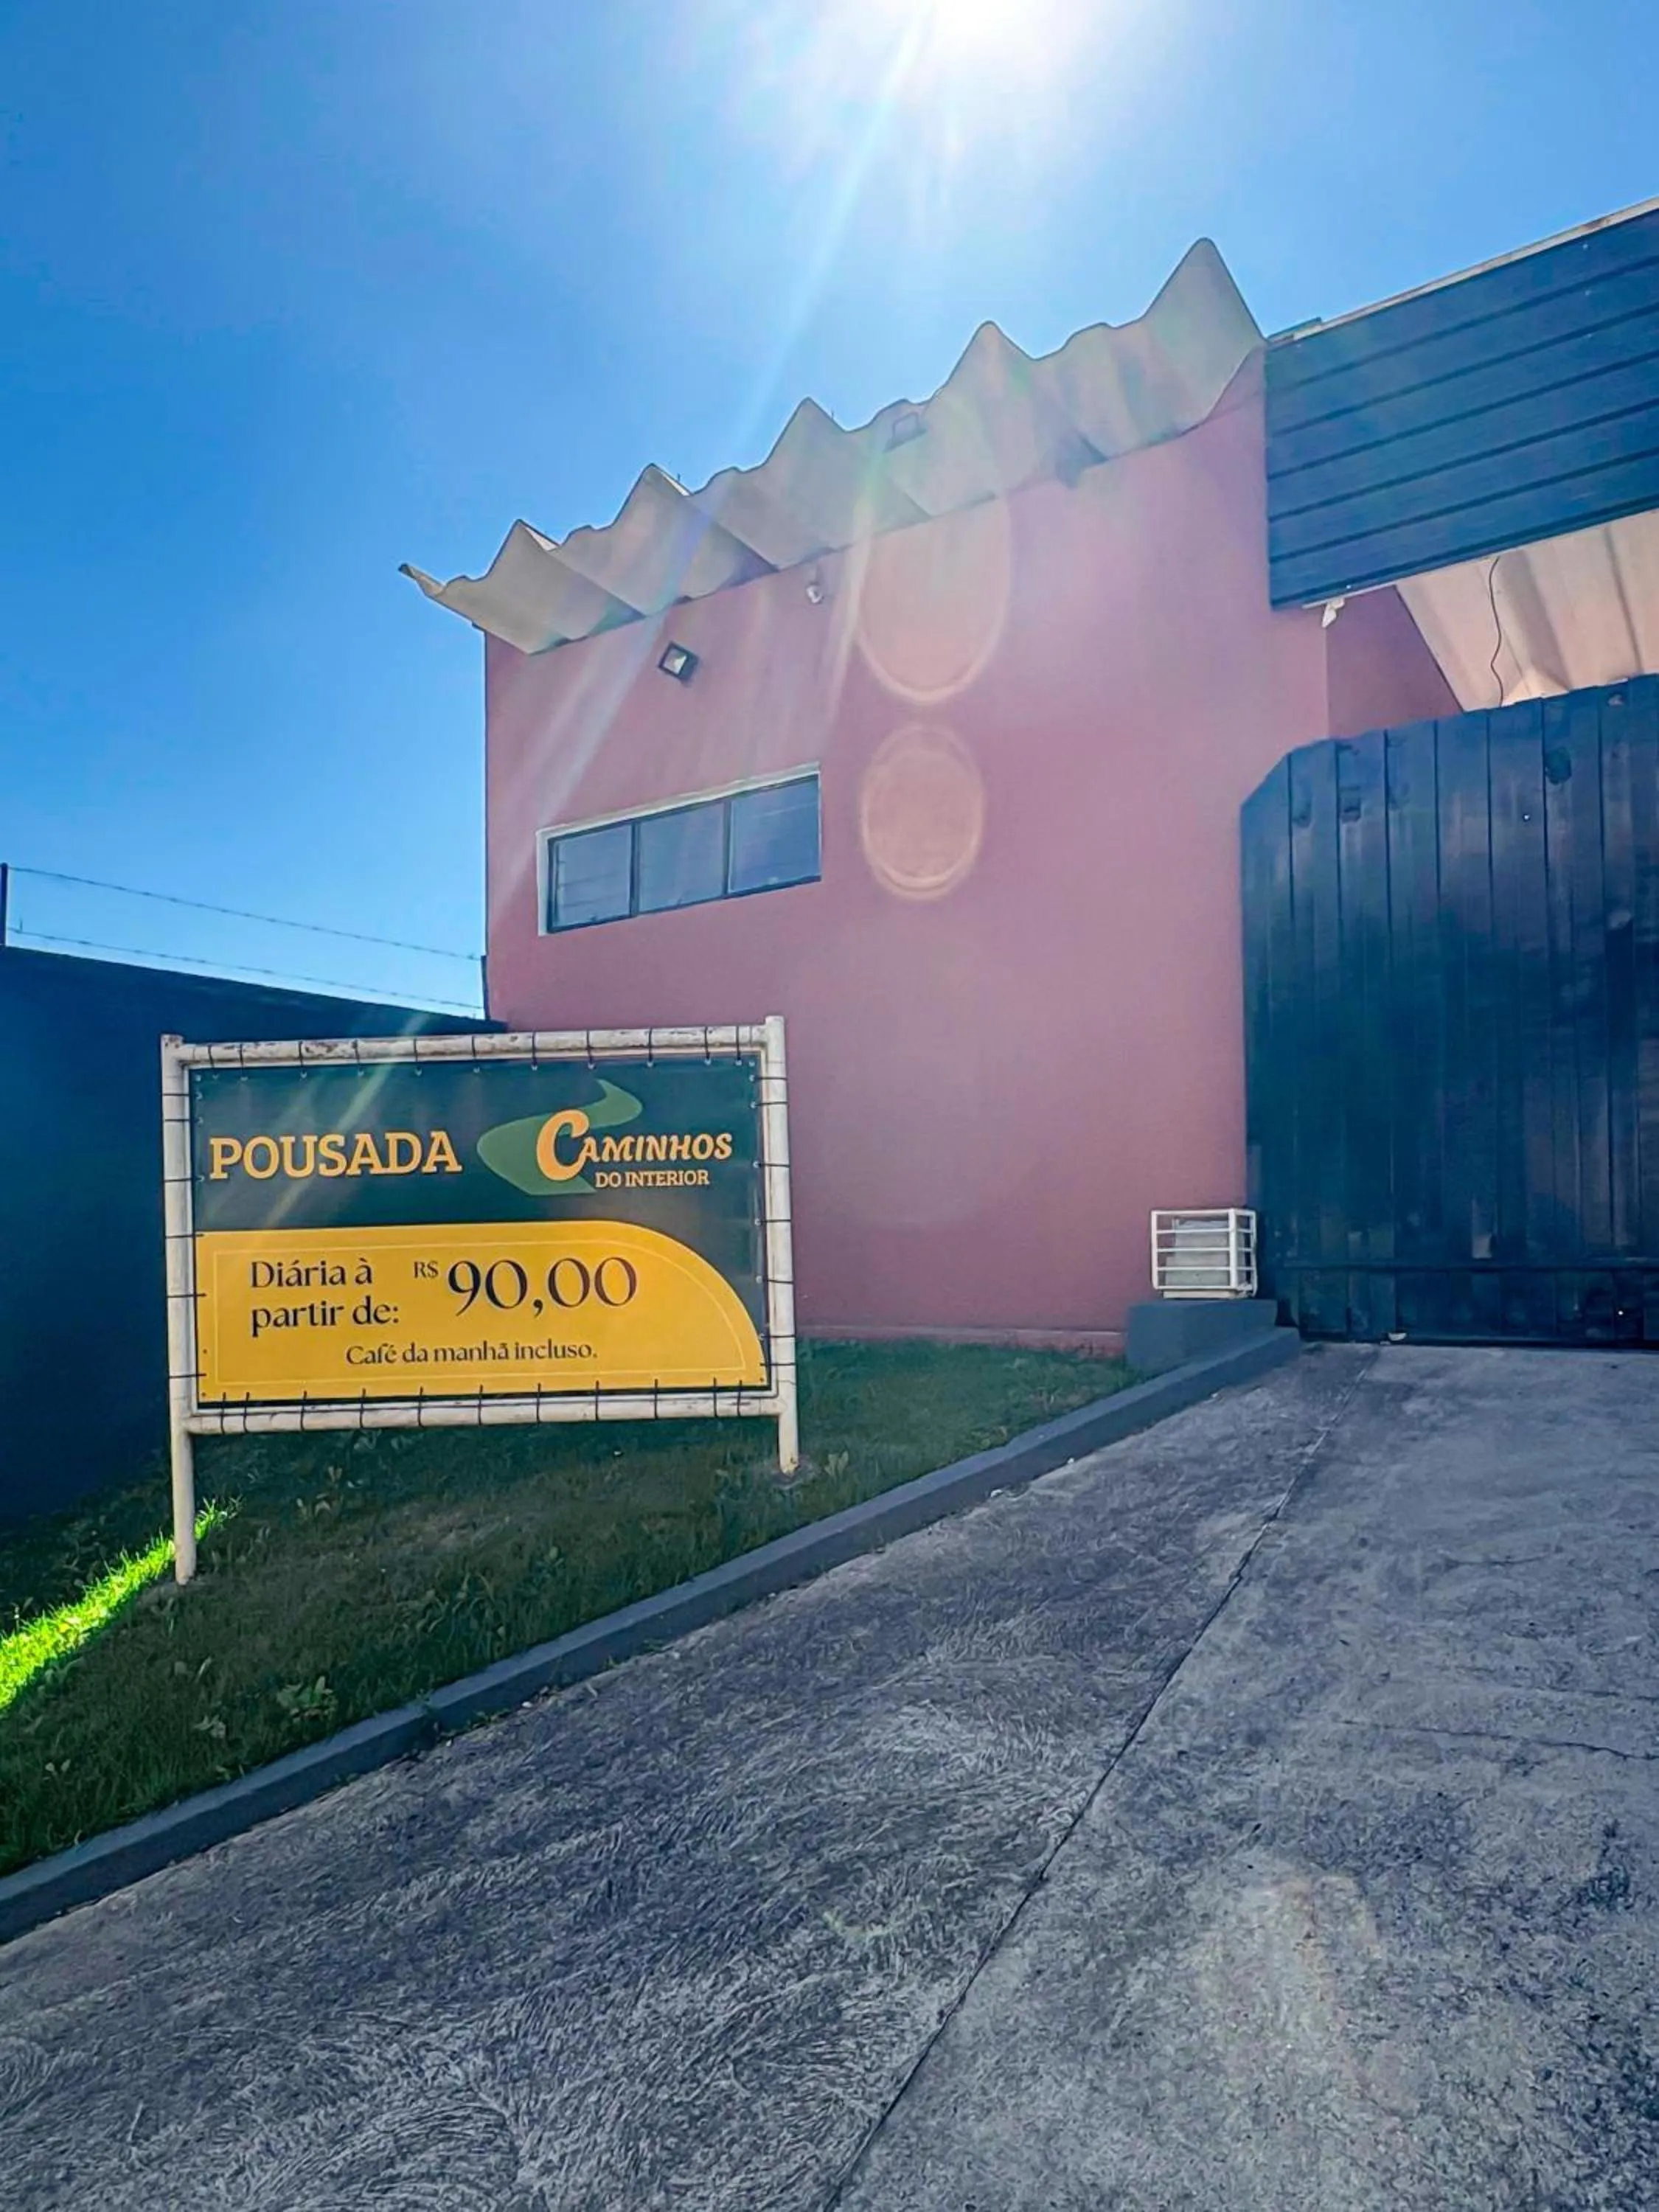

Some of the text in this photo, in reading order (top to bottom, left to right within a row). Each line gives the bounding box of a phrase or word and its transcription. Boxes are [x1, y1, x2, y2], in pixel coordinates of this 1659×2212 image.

[209, 1109, 733, 1181] POUSADA CAMINHOS
[595, 1169, 710, 1188] DO INTERIOR
[251, 1257, 373, 1288] Diária à
[413, 1256, 638, 1317] R$ 90,00
[251, 1295, 400, 1338] partir de:
[346, 1338, 598, 1365] Café da manhã incluso.
